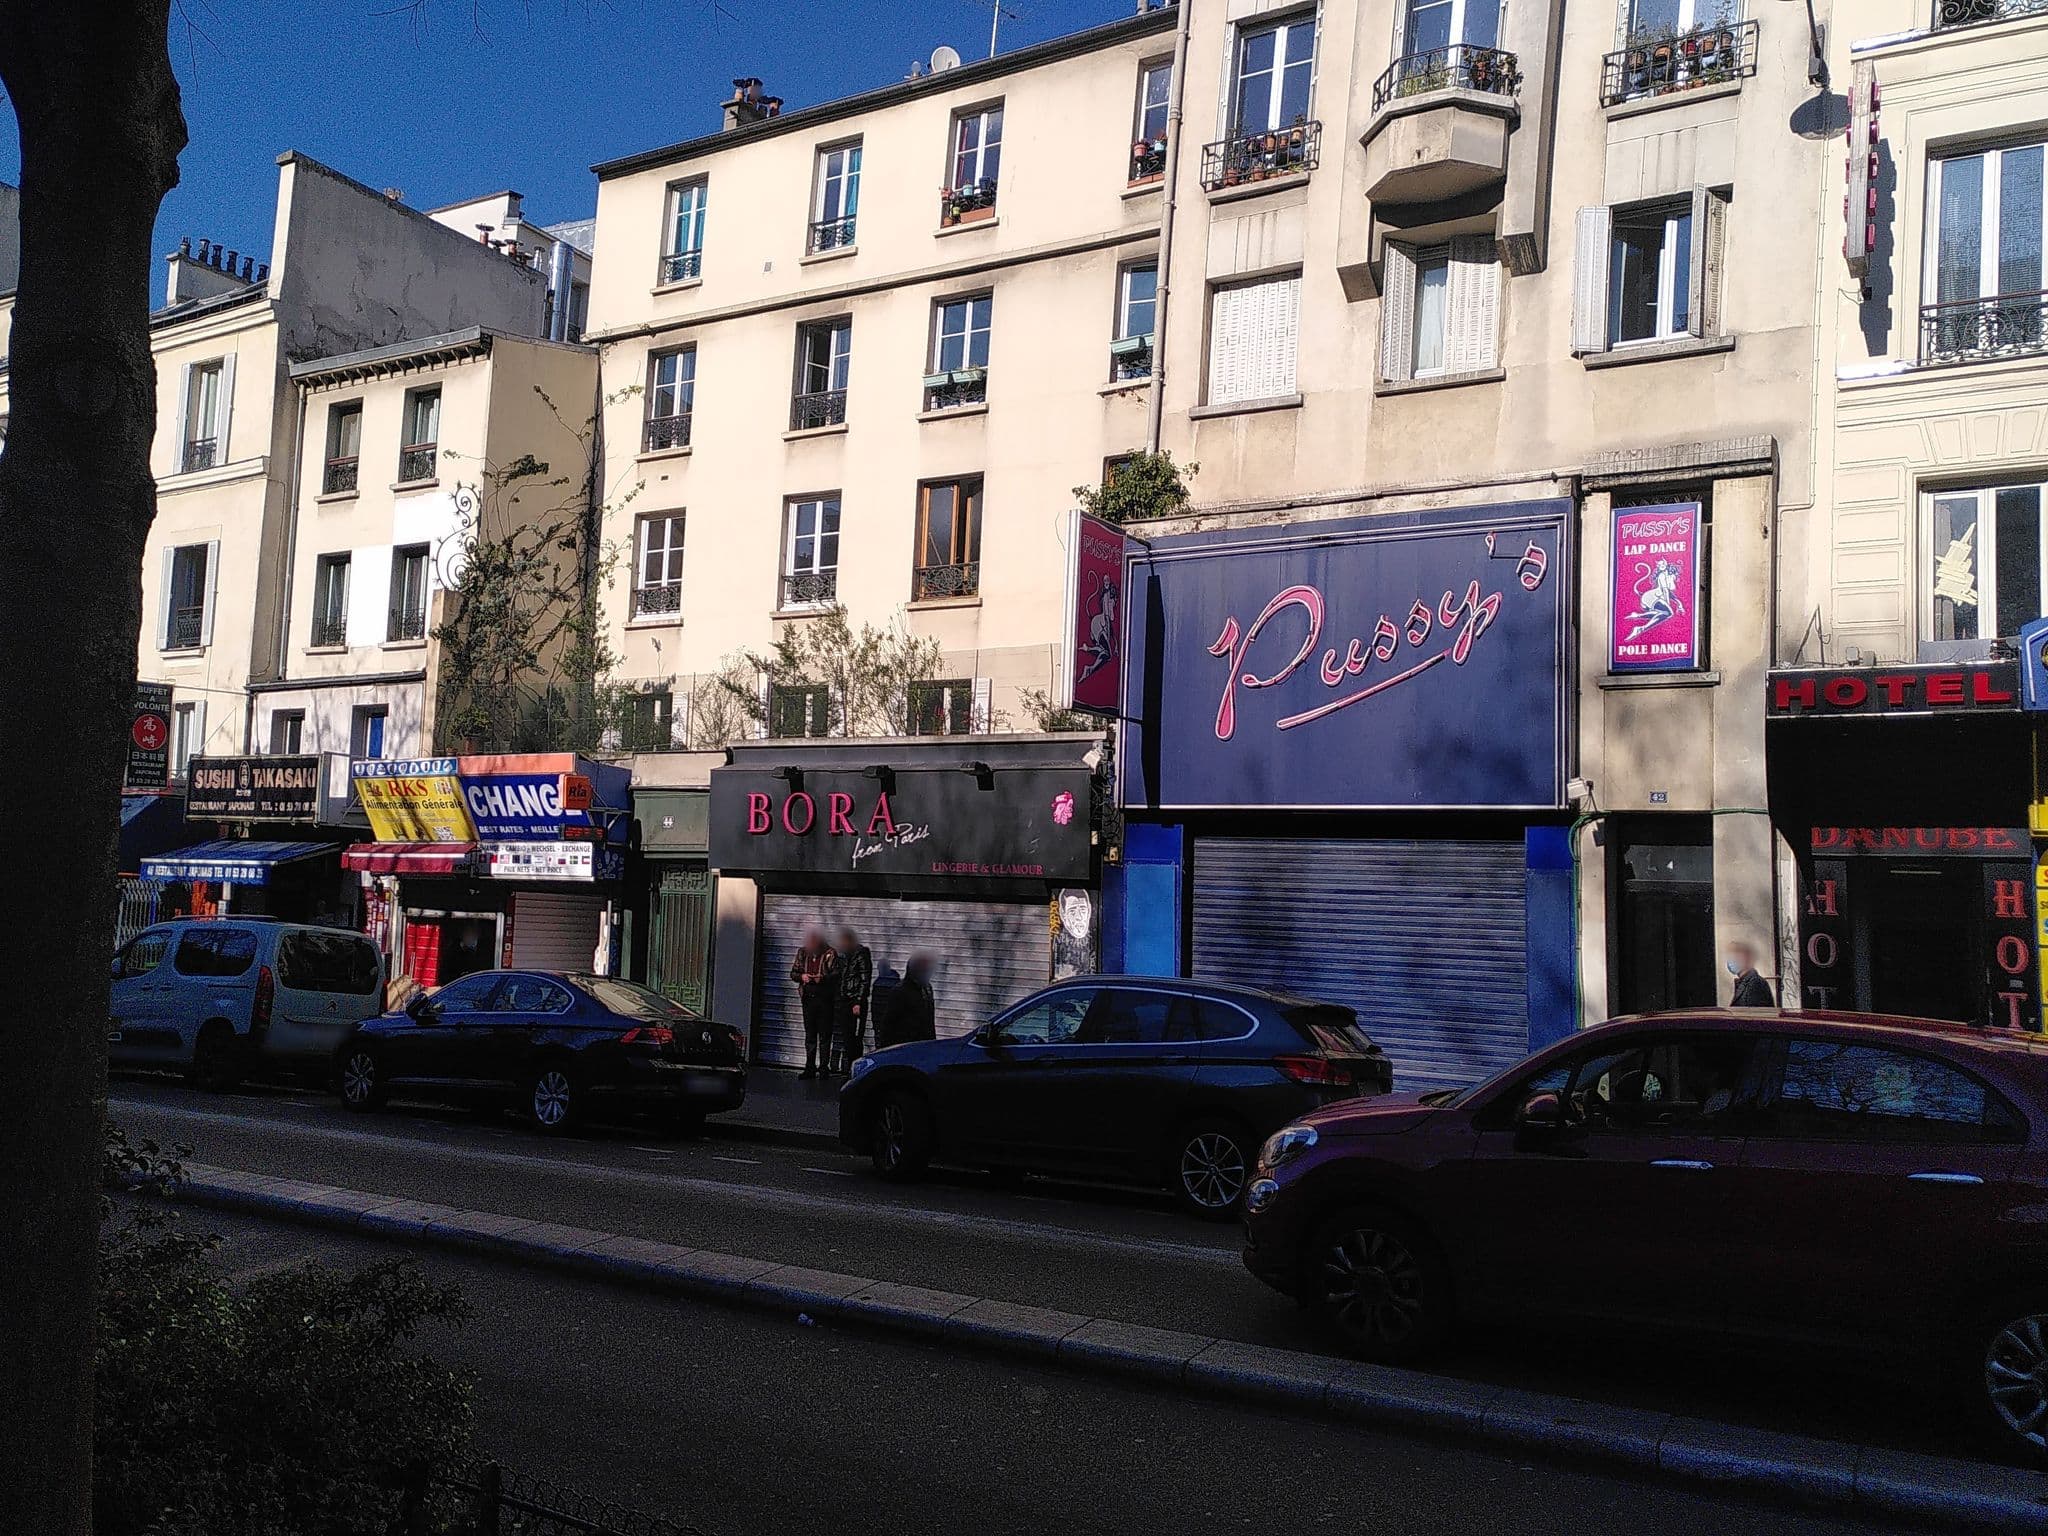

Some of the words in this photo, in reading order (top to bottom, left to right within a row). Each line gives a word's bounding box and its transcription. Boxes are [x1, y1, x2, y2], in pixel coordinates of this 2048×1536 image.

[1622, 516, 1691, 539] PUSSY'S
[1624, 544, 1646, 556] LAP
[1650, 541, 1686, 553] DANCE
[1207, 531, 1548, 741] Pussy's
[1618, 644, 1648, 656] POLE
[1651, 643, 1687, 655] DANCE
[137, 686, 168, 696] BUFFET
[1775, 672, 2013, 710] HOTEL
[195, 769, 235, 789] SUSHI
[252, 767, 317, 788] TAKASAKI
[386, 780, 428, 797] RKS
[568, 783, 587, 798] Ria
[366, 799, 420, 810] Alimentation
[422, 798, 464, 809] Générale
[747, 791, 896, 836] BORA
[479, 825, 498, 834] BEST
[500, 825, 524, 834] RATES
[885, 822, 930, 848] Paris
[1811, 826, 2017, 849] DANUBE
[562, 845, 591, 853] EXCHANGE
[932, 862, 978, 874] LINGERIE
[980, 864, 989, 873] &
[991, 863, 1043, 876] GLAMOUR
